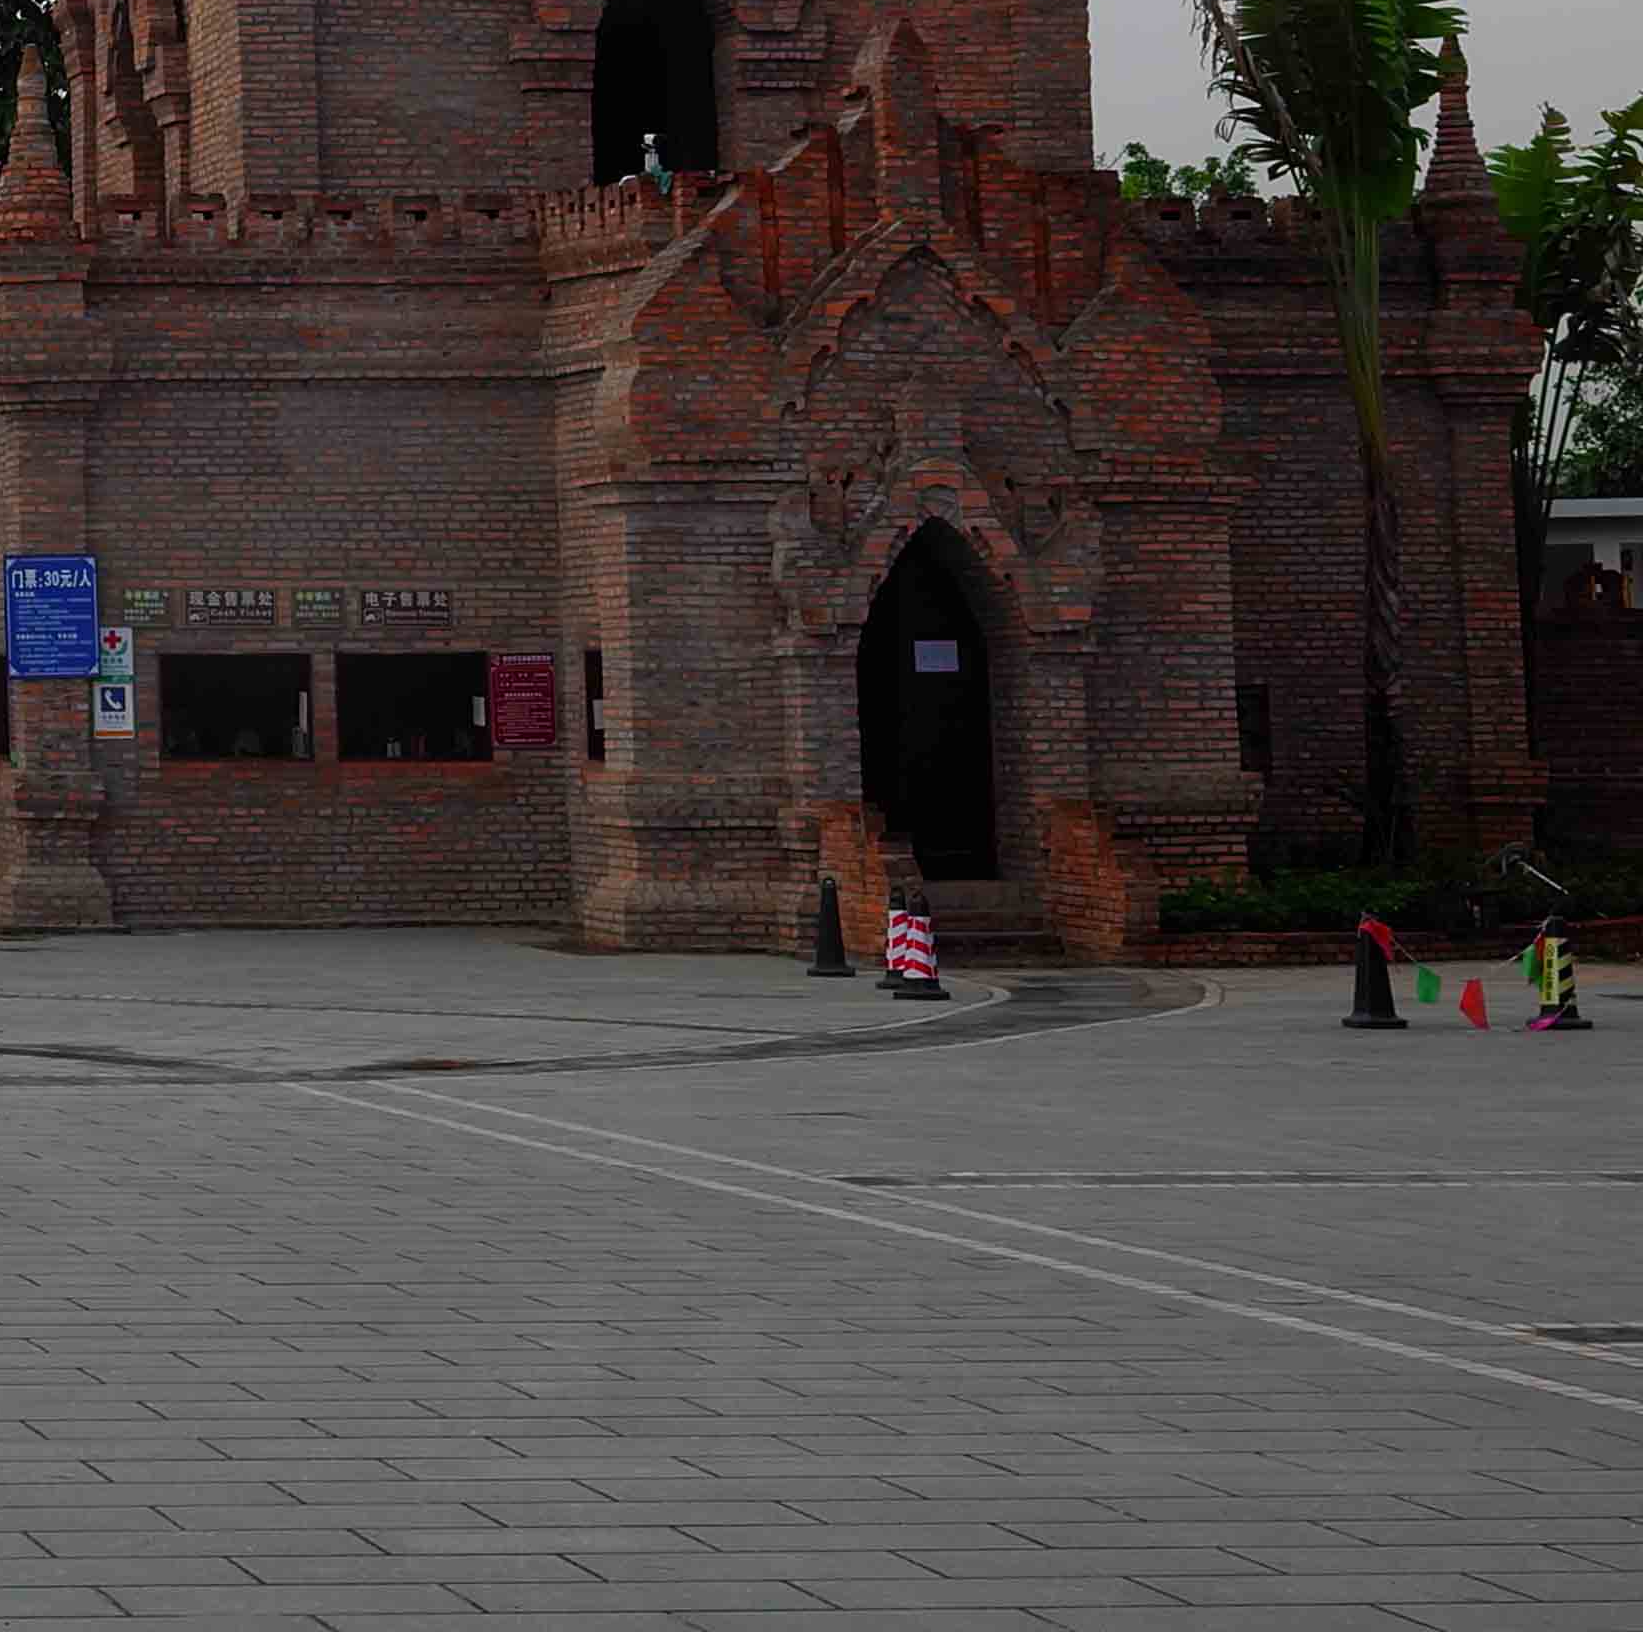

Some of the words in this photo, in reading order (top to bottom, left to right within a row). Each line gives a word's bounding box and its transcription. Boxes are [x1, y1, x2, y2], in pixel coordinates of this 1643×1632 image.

[188, 591, 273, 608] 现金售票处
[363, 591, 449, 608] 电子售票处
